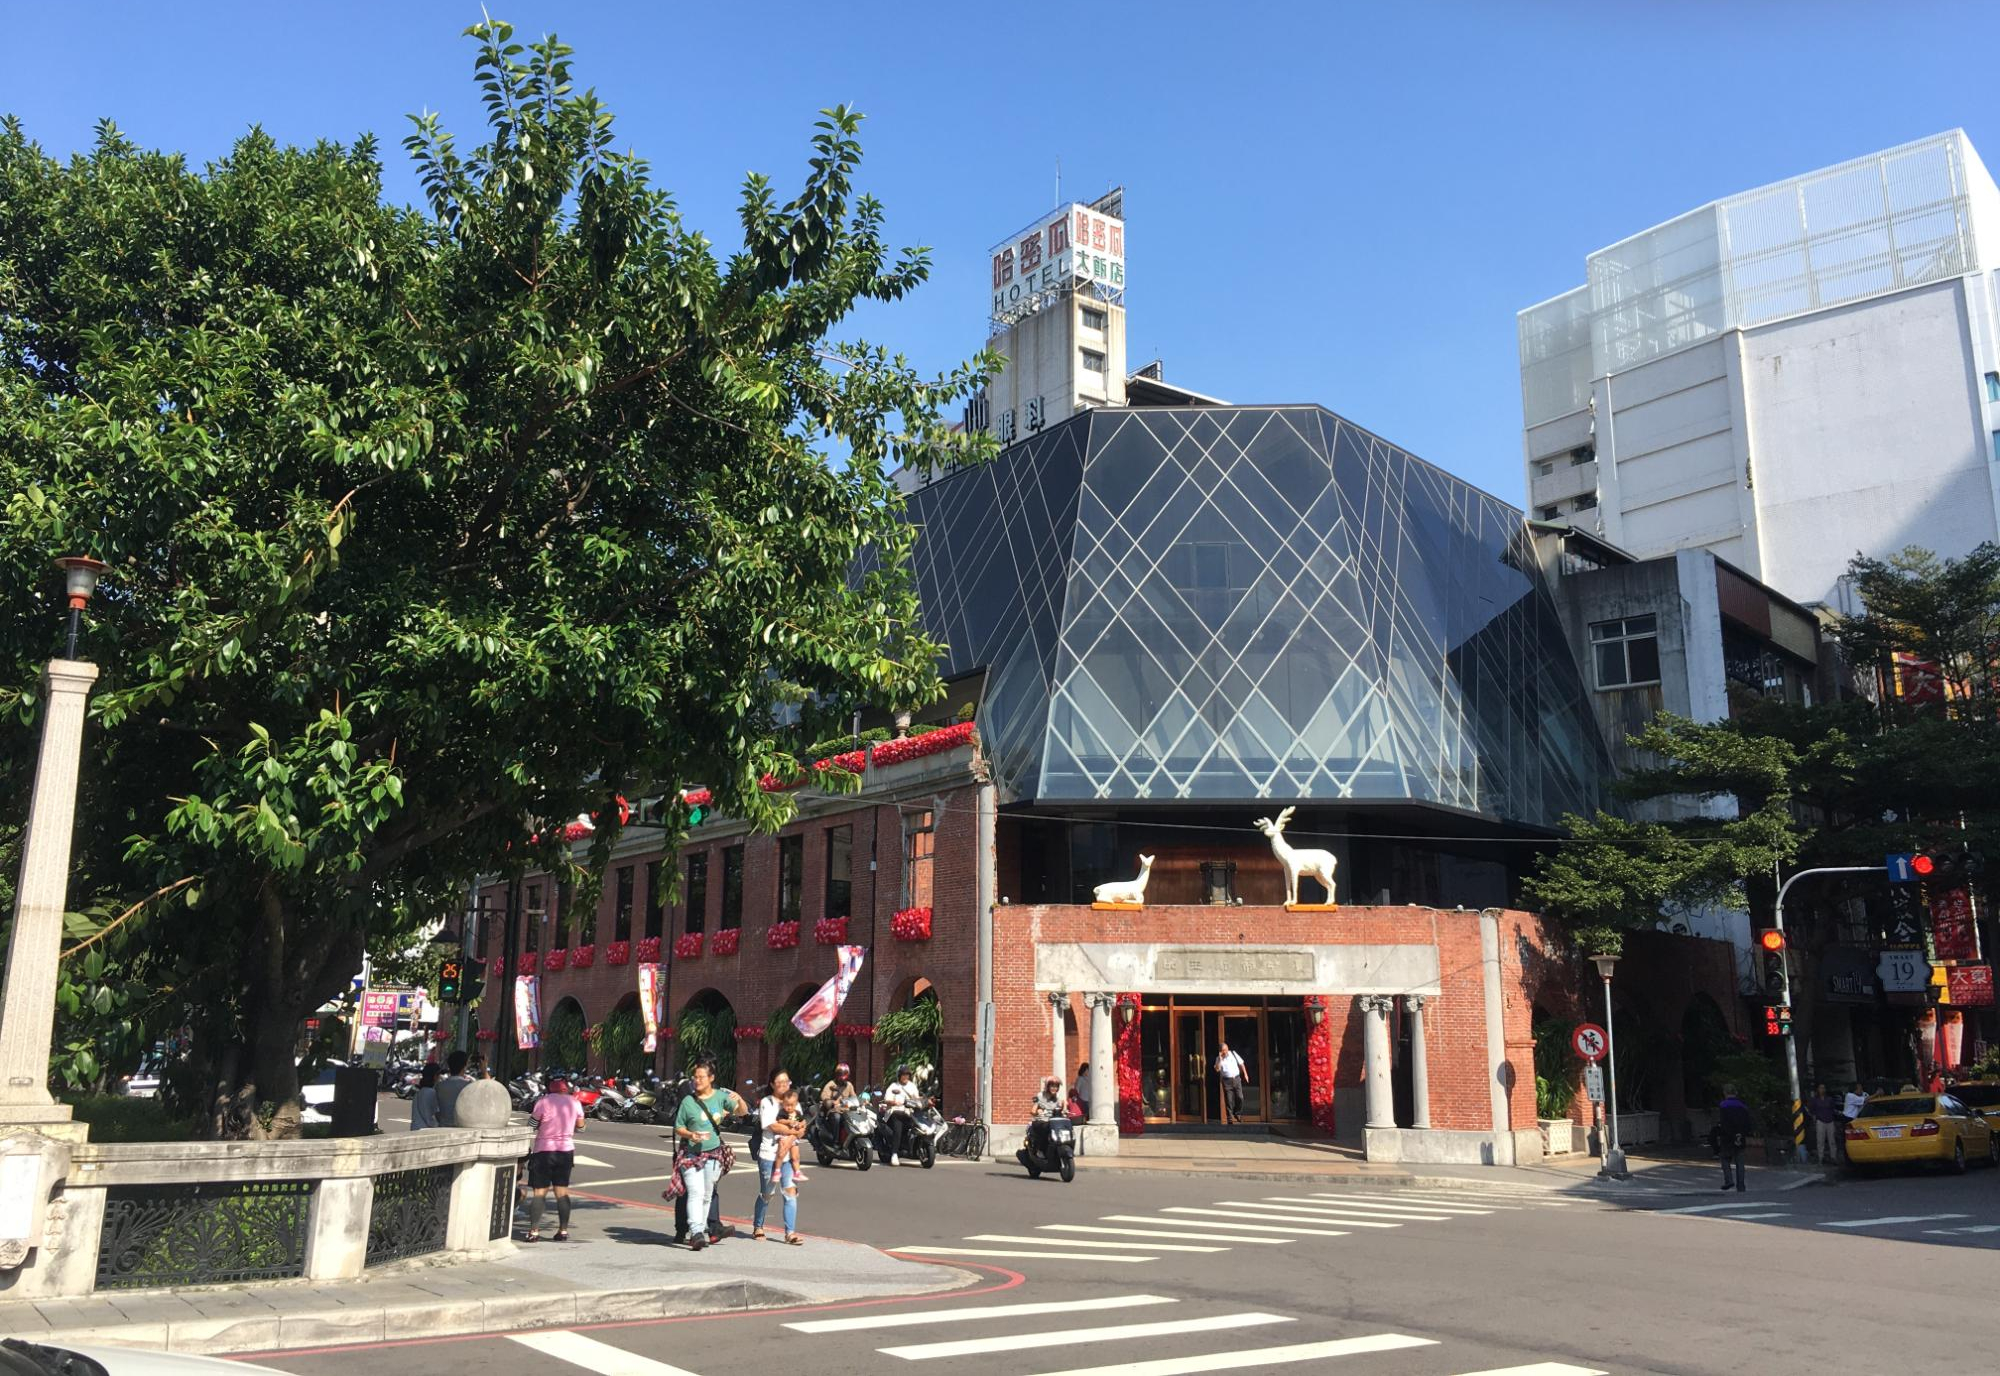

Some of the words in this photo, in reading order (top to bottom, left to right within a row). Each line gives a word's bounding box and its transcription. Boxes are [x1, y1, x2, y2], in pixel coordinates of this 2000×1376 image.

[993, 211, 1070, 288] 哈密瓜
[1074, 210, 1124, 259] 哈密瓜
[994, 257, 1071, 313] HOTEL
[1076, 249, 1125, 287] 大飯店
[442, 963, 458, 979] 25
[1892, 962, 1915, 982] 19
[1767, 1022, 1780, 1035] 33
